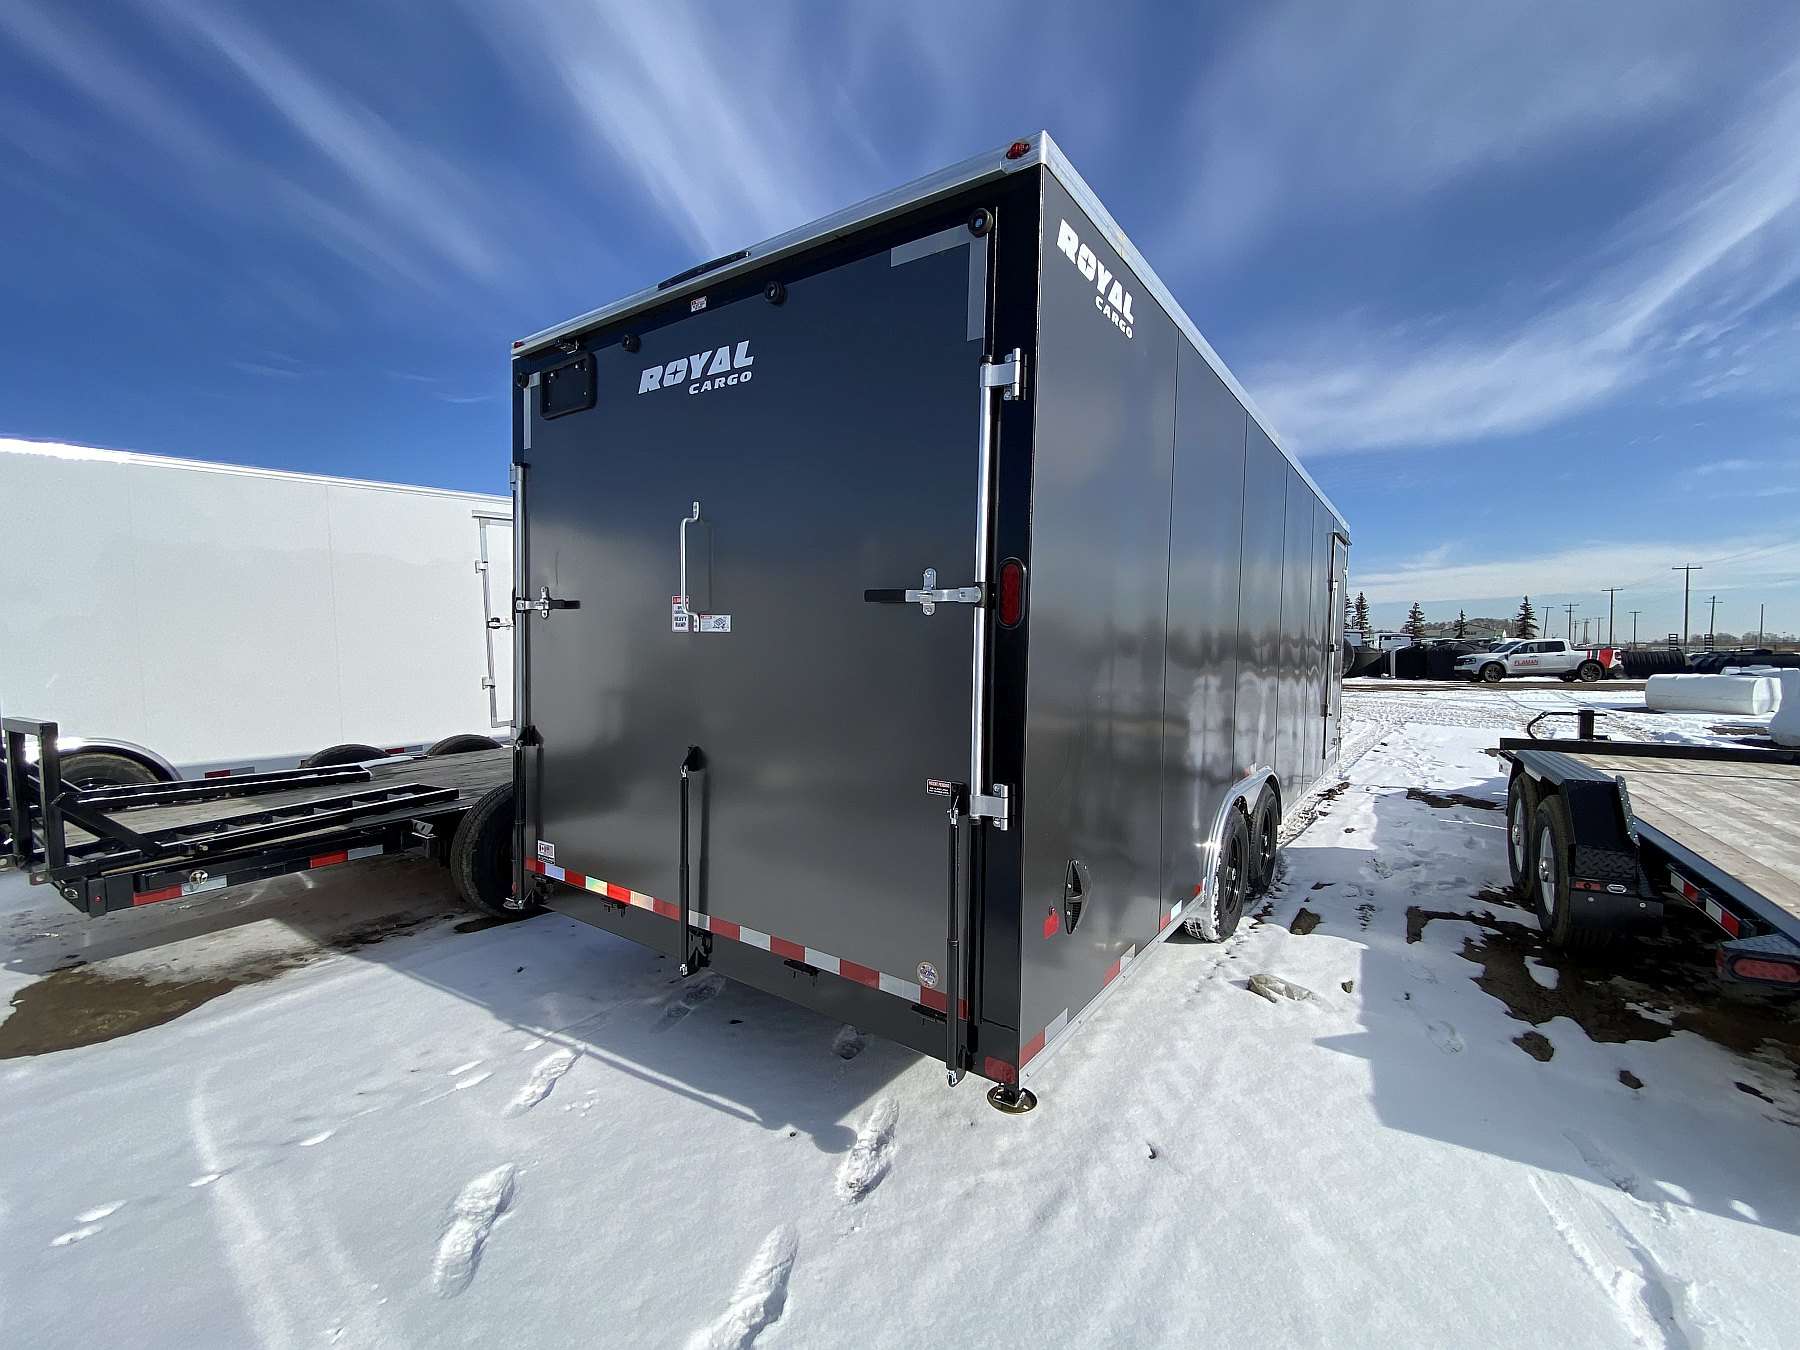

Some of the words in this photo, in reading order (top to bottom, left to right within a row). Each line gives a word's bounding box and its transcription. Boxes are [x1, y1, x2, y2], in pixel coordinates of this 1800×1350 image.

[1057, 218, 1134, 325] ROYAL
[1095, 295, 1133, 339] CARGO
[638, 340, 754, 394] ROYAL
[689, 371, 752, 395] CARGO
